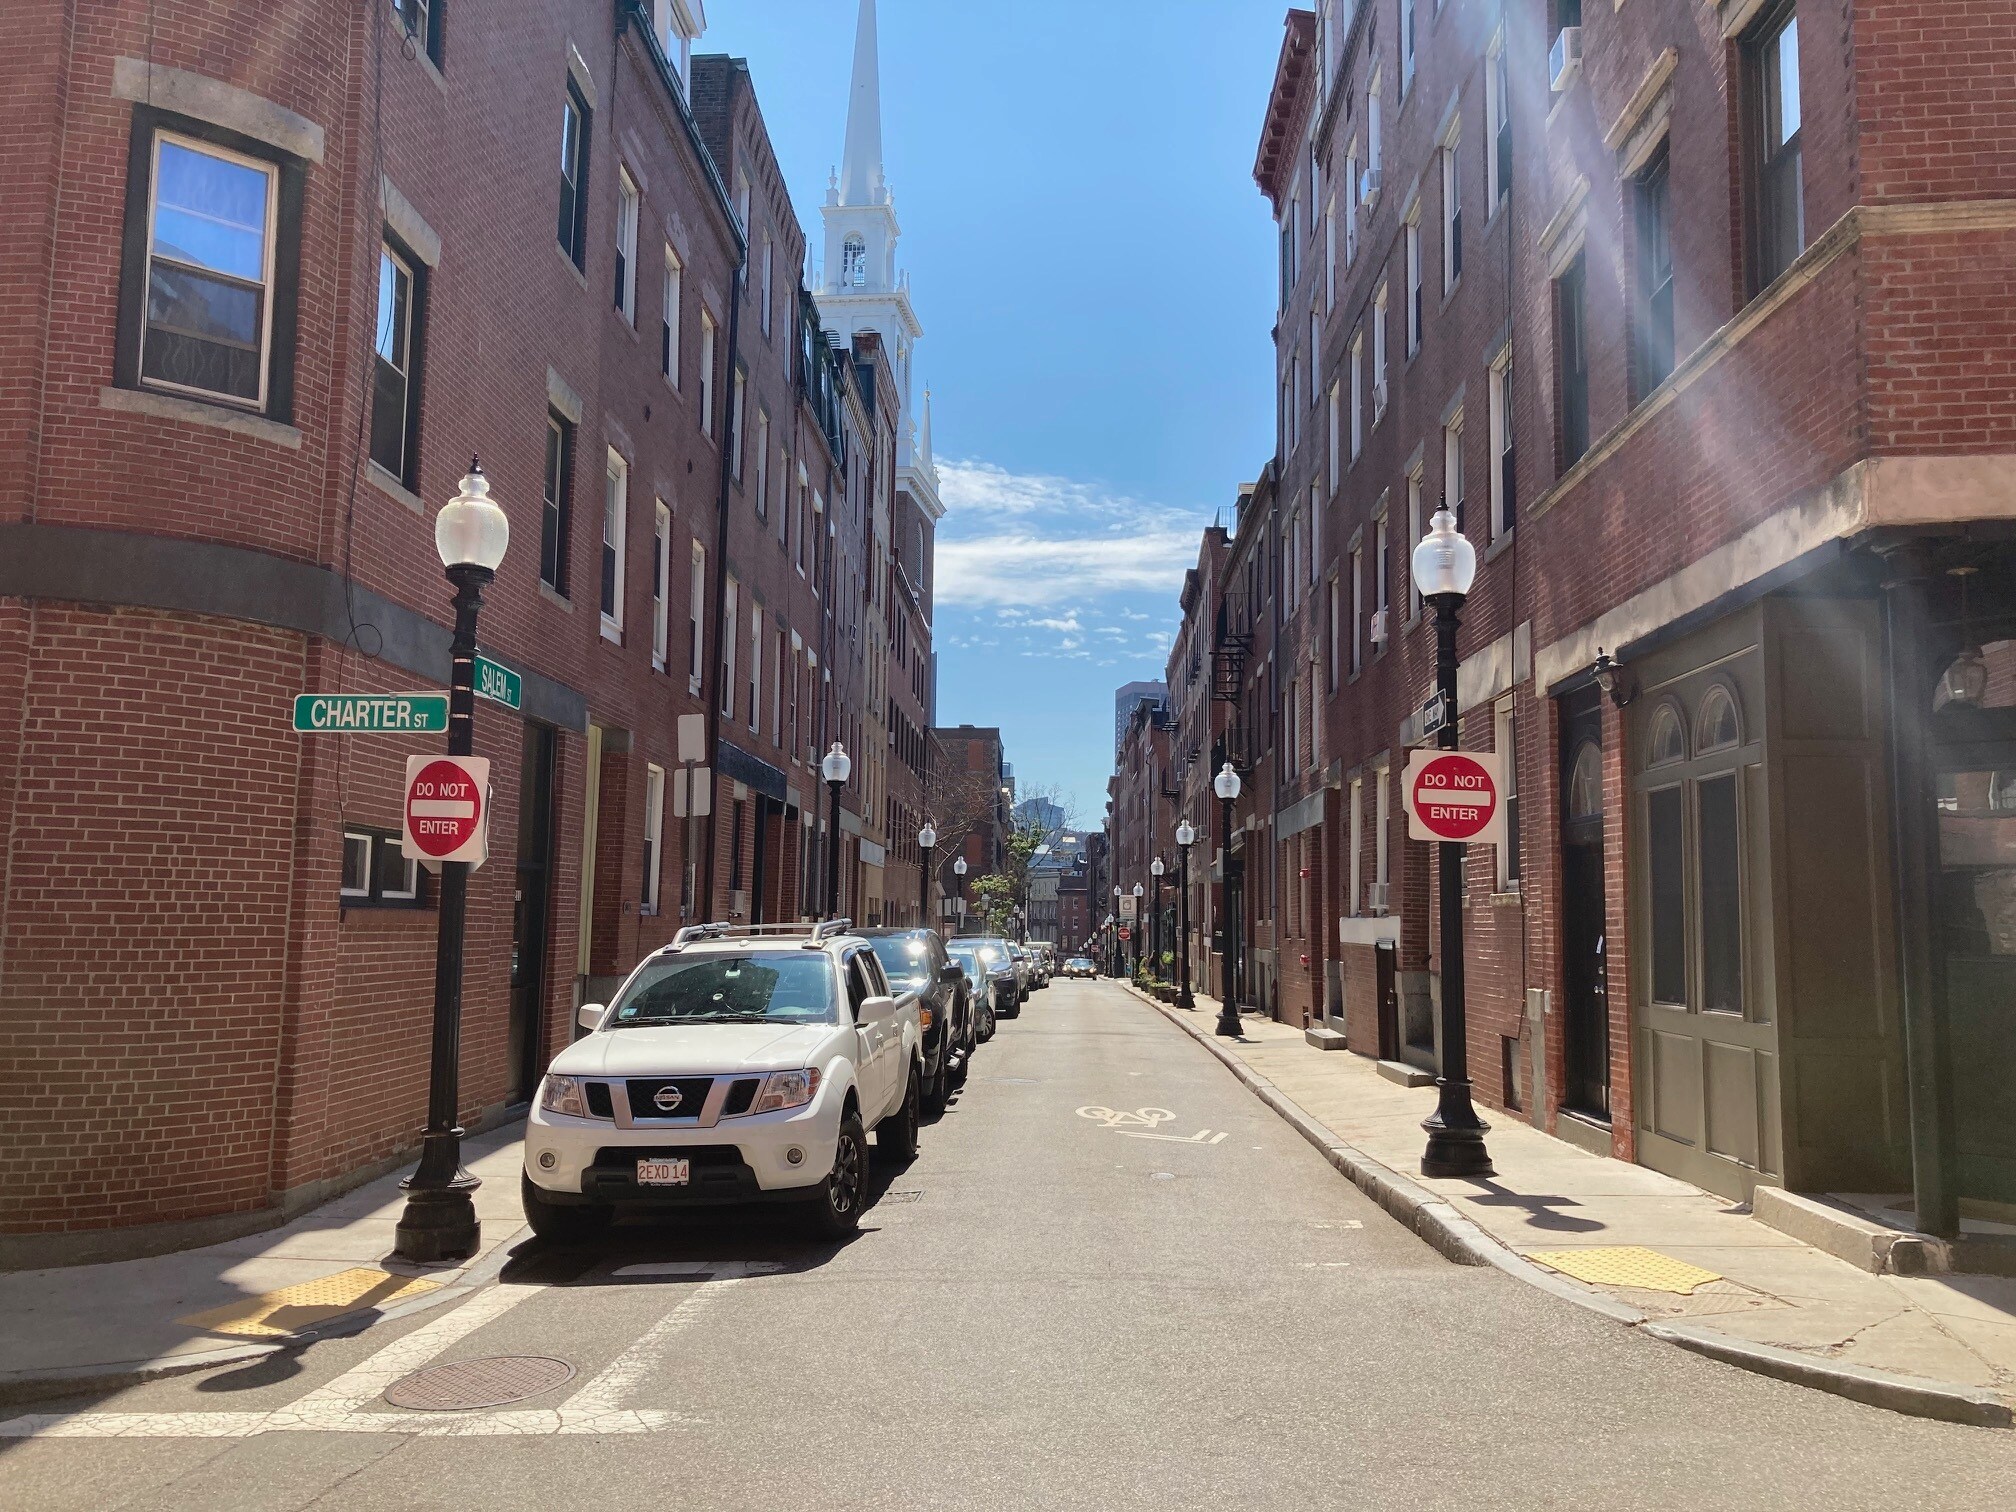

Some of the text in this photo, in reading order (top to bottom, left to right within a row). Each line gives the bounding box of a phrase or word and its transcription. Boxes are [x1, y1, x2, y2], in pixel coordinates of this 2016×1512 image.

[481, 665, 512, 703] SALEM ST
[311, 699, 428, 728] CHARTER ST
[1424, 773, 1484, 788] DO NOT
[416, 782, 469, 798] DO NOT
[1430, 806, 1478, 821] ENTER
[419, 820, 459, 836] ENTER
[638, 1164, 688, 1180] 2EXD 14
